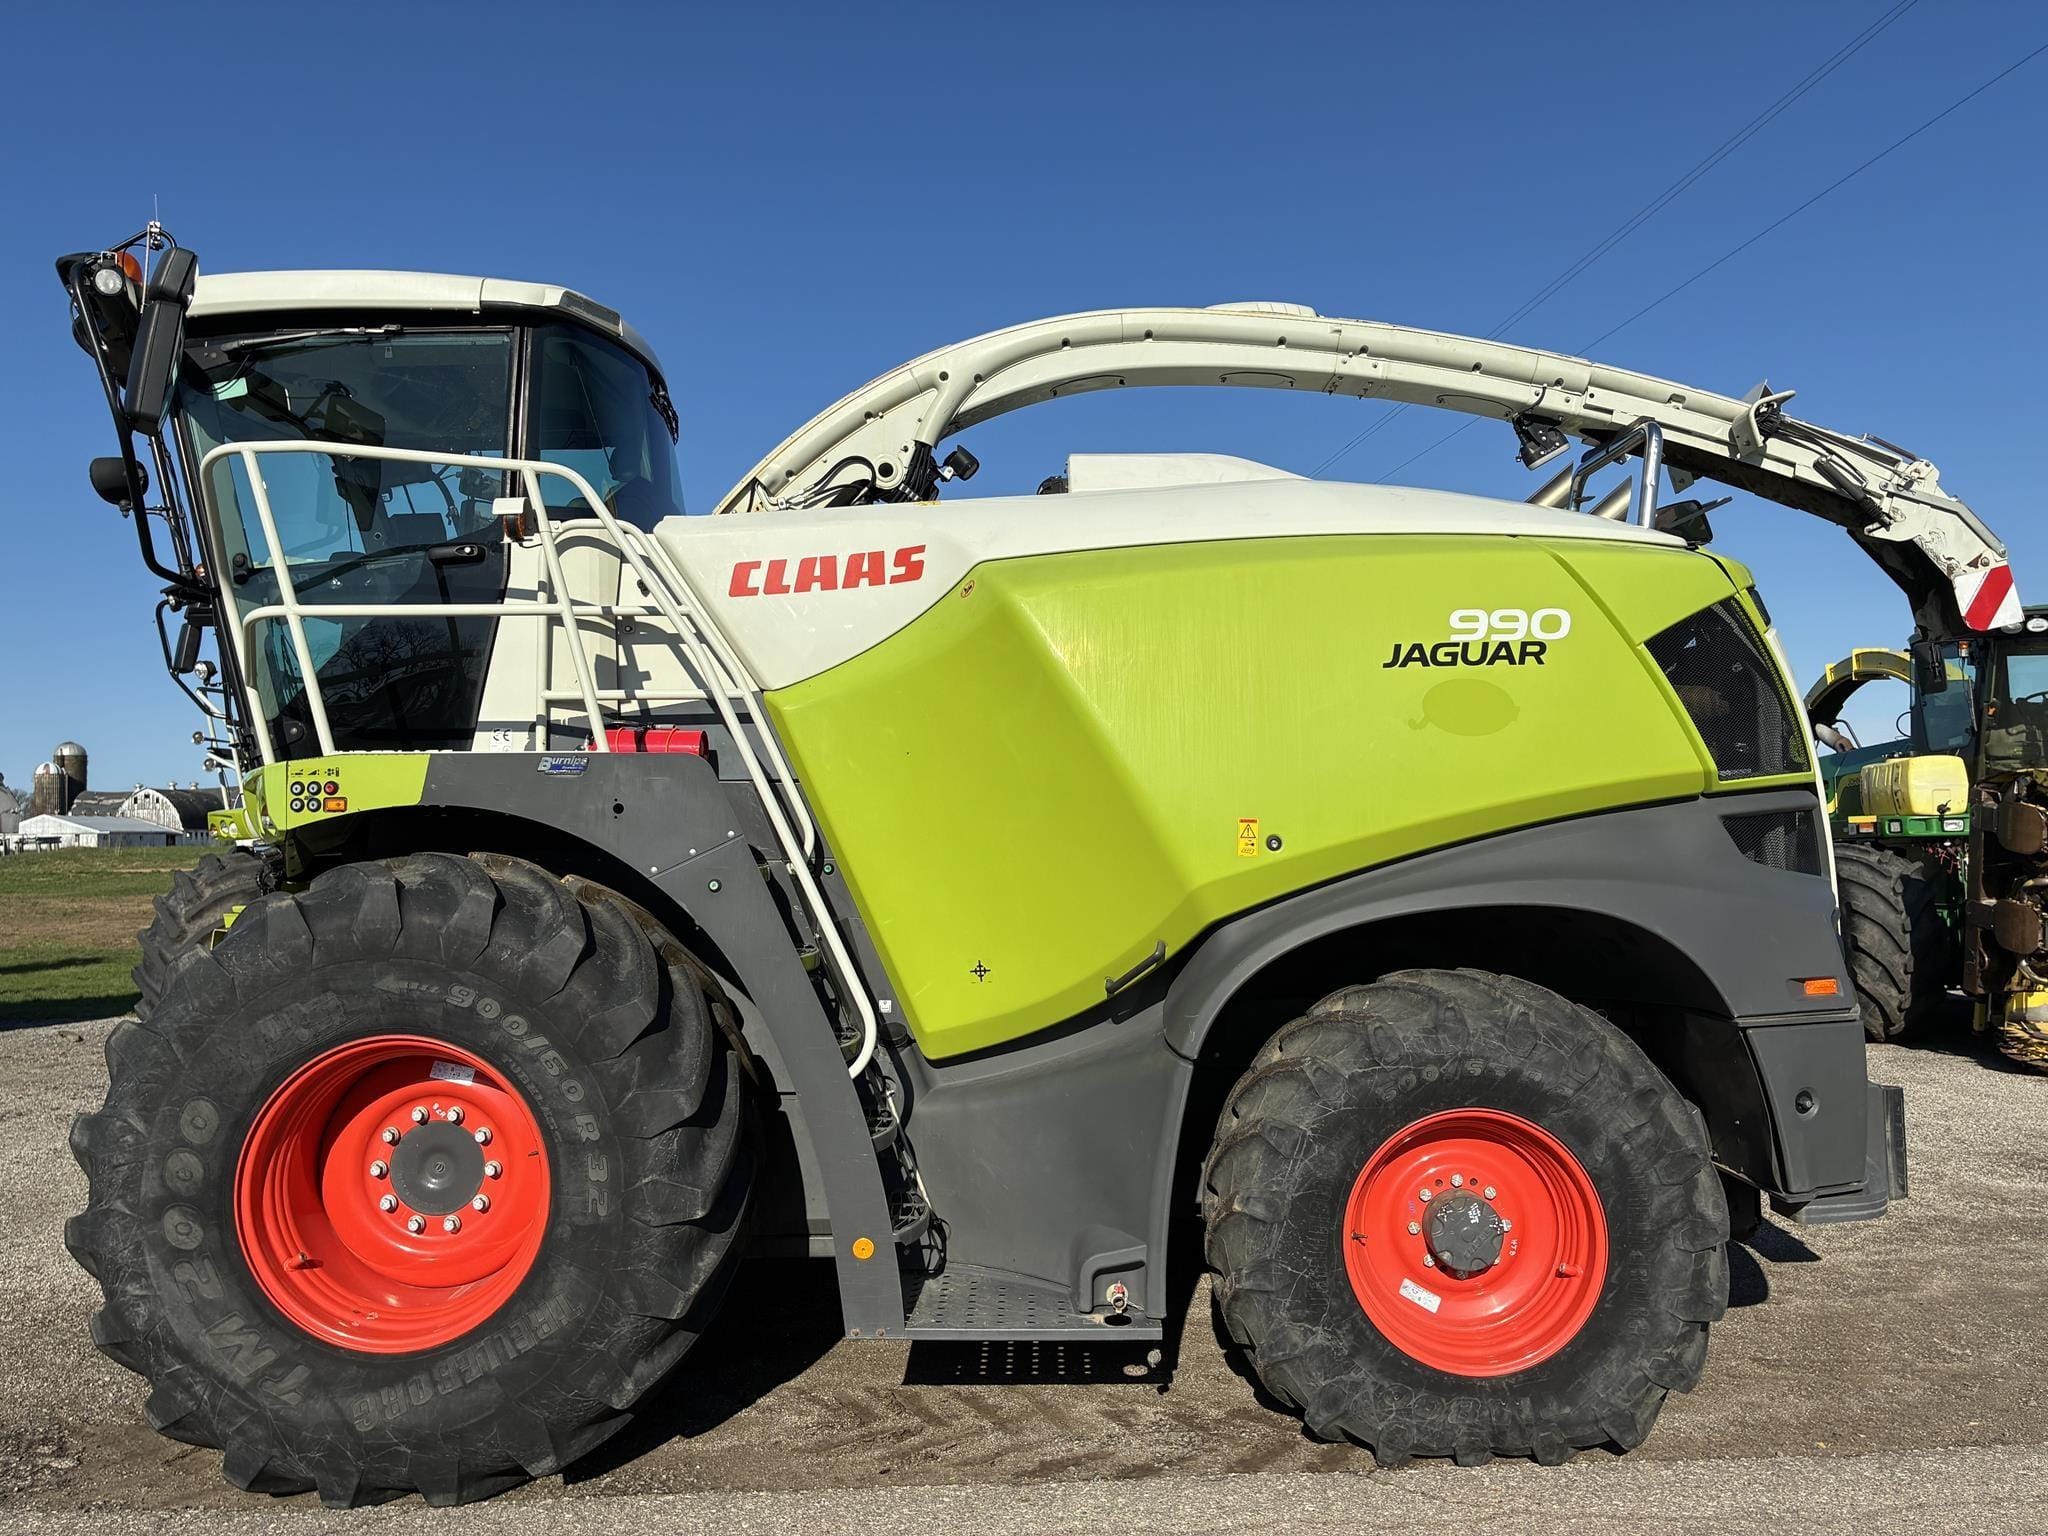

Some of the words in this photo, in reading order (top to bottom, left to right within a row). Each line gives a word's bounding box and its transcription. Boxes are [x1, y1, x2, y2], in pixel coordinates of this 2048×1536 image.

[728, 544, 926, 597] CLAAS
[1449, 608, 1571, 641] 990
[1382, 640, 1548, 668] JAGUAR
[537, 755, 588, 771] Burnips
[446, 983, 585, 1103] 900/60
[586, 1151, 609, 1218] 32
[352, 1293, 585, 1432] TRELLEBORG
